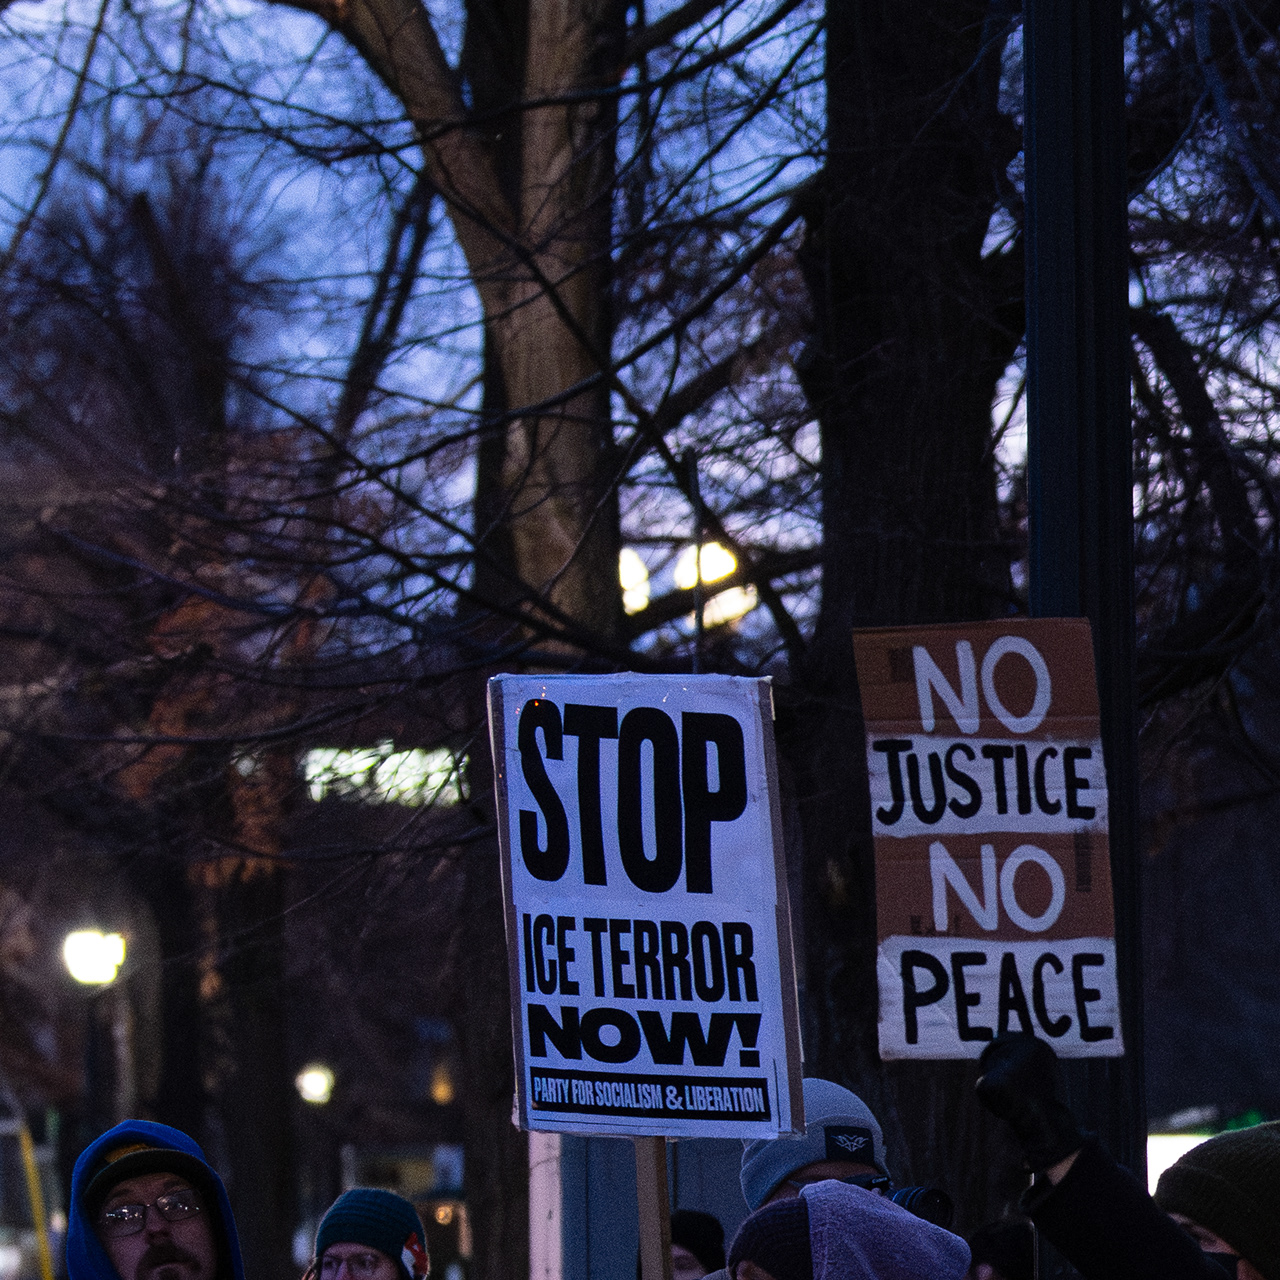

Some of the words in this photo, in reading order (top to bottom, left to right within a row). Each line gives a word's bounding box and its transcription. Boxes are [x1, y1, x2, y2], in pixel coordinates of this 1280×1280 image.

[911, 635, 1052, 735] NO
[517, 698, 747, 894] STOP
[872, 739, 1096, 825] JUSTICE
[928, 840, 1066, 933] NO
[523, 913, 580, 996] ICE
[583, 917, 759, 1003] TERROR
[901, 949, 1114, 1044] PEACE
[527, 1003, 762, 1068] NOW!
[533, 1077, 571, 1104] PARTY
[571, 1079, 595, 1106] FOR
[595, 1081, 663, 1110] SOCIALISM
[665, 1085, 684, 1111] &
[684, 1085, 766, 1113] LIBERATION
